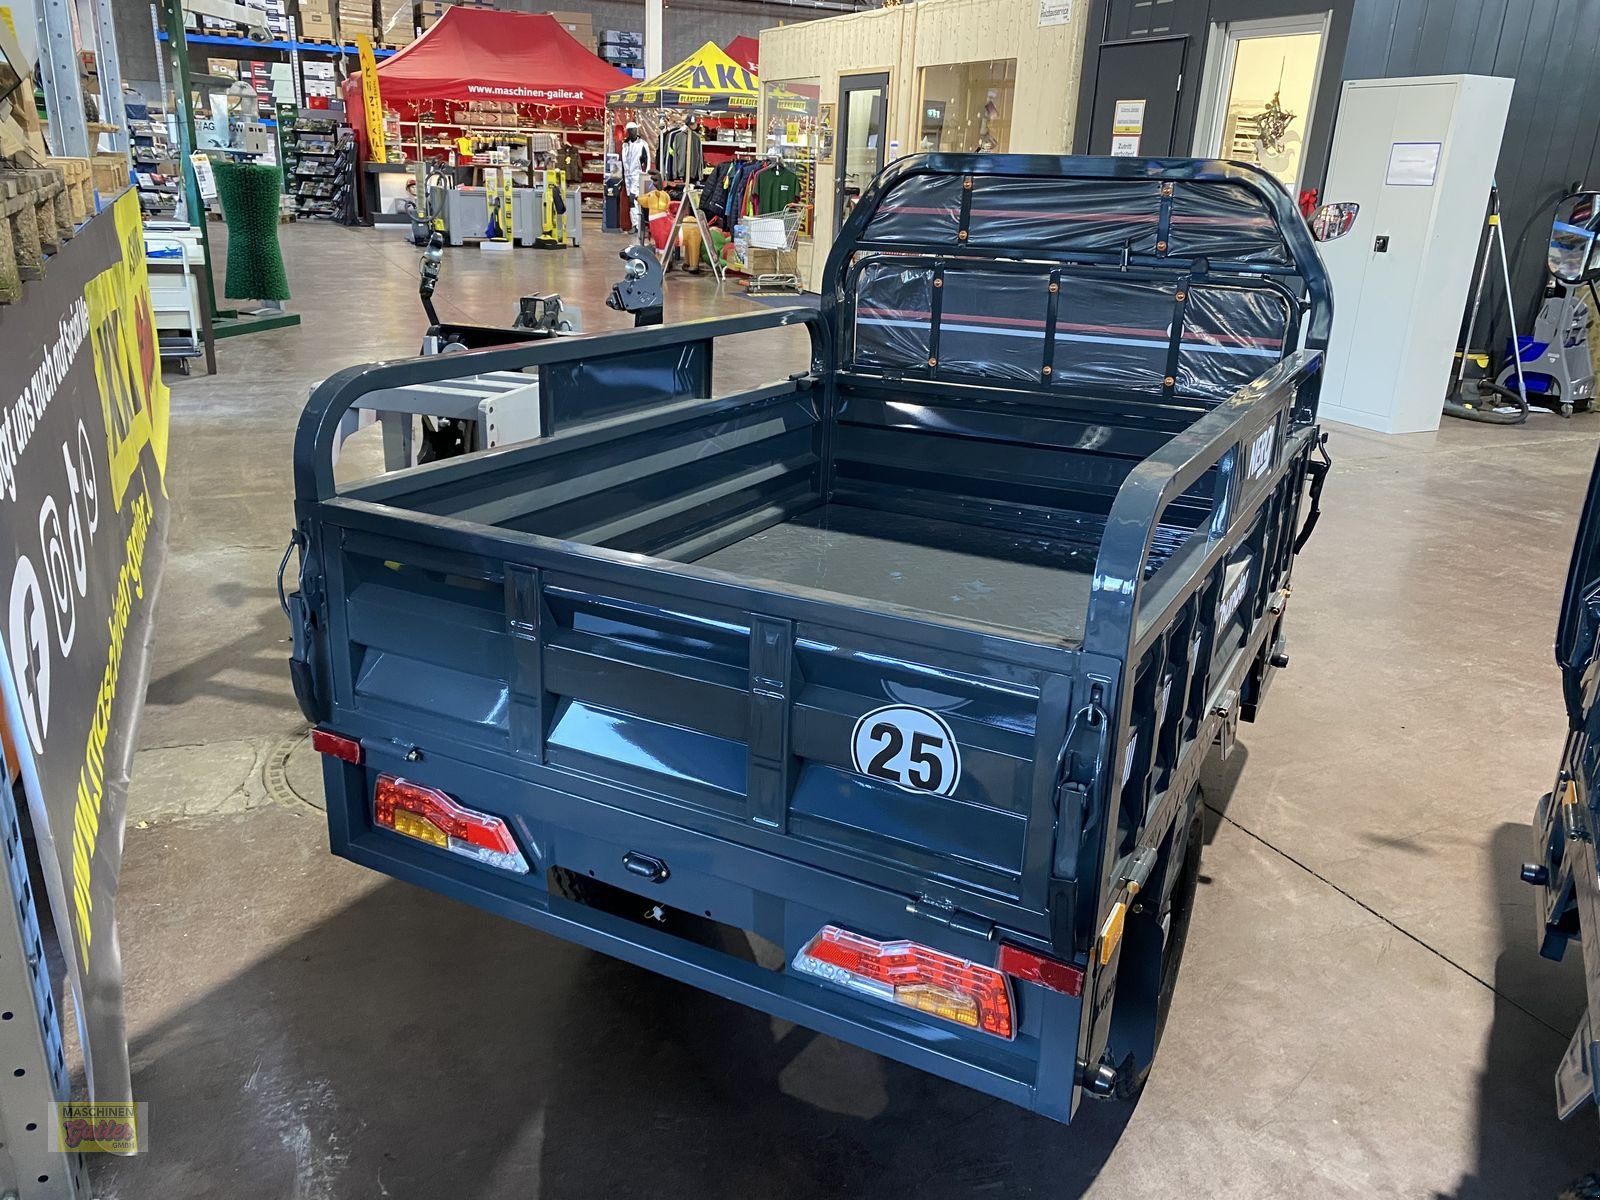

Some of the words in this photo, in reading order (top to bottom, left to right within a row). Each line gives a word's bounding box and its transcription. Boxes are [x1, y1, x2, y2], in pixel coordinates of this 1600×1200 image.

[468, 85, 583, 99] www.maschinen-gailer.at
[12, 387, 36, 455] uns
[31, 343, 57, 421] auch
[52, 320, 69, 385] auf
[73, 466, 153, 975] www.maschinen-gailer.
[867, 722, 943, 792] 25
